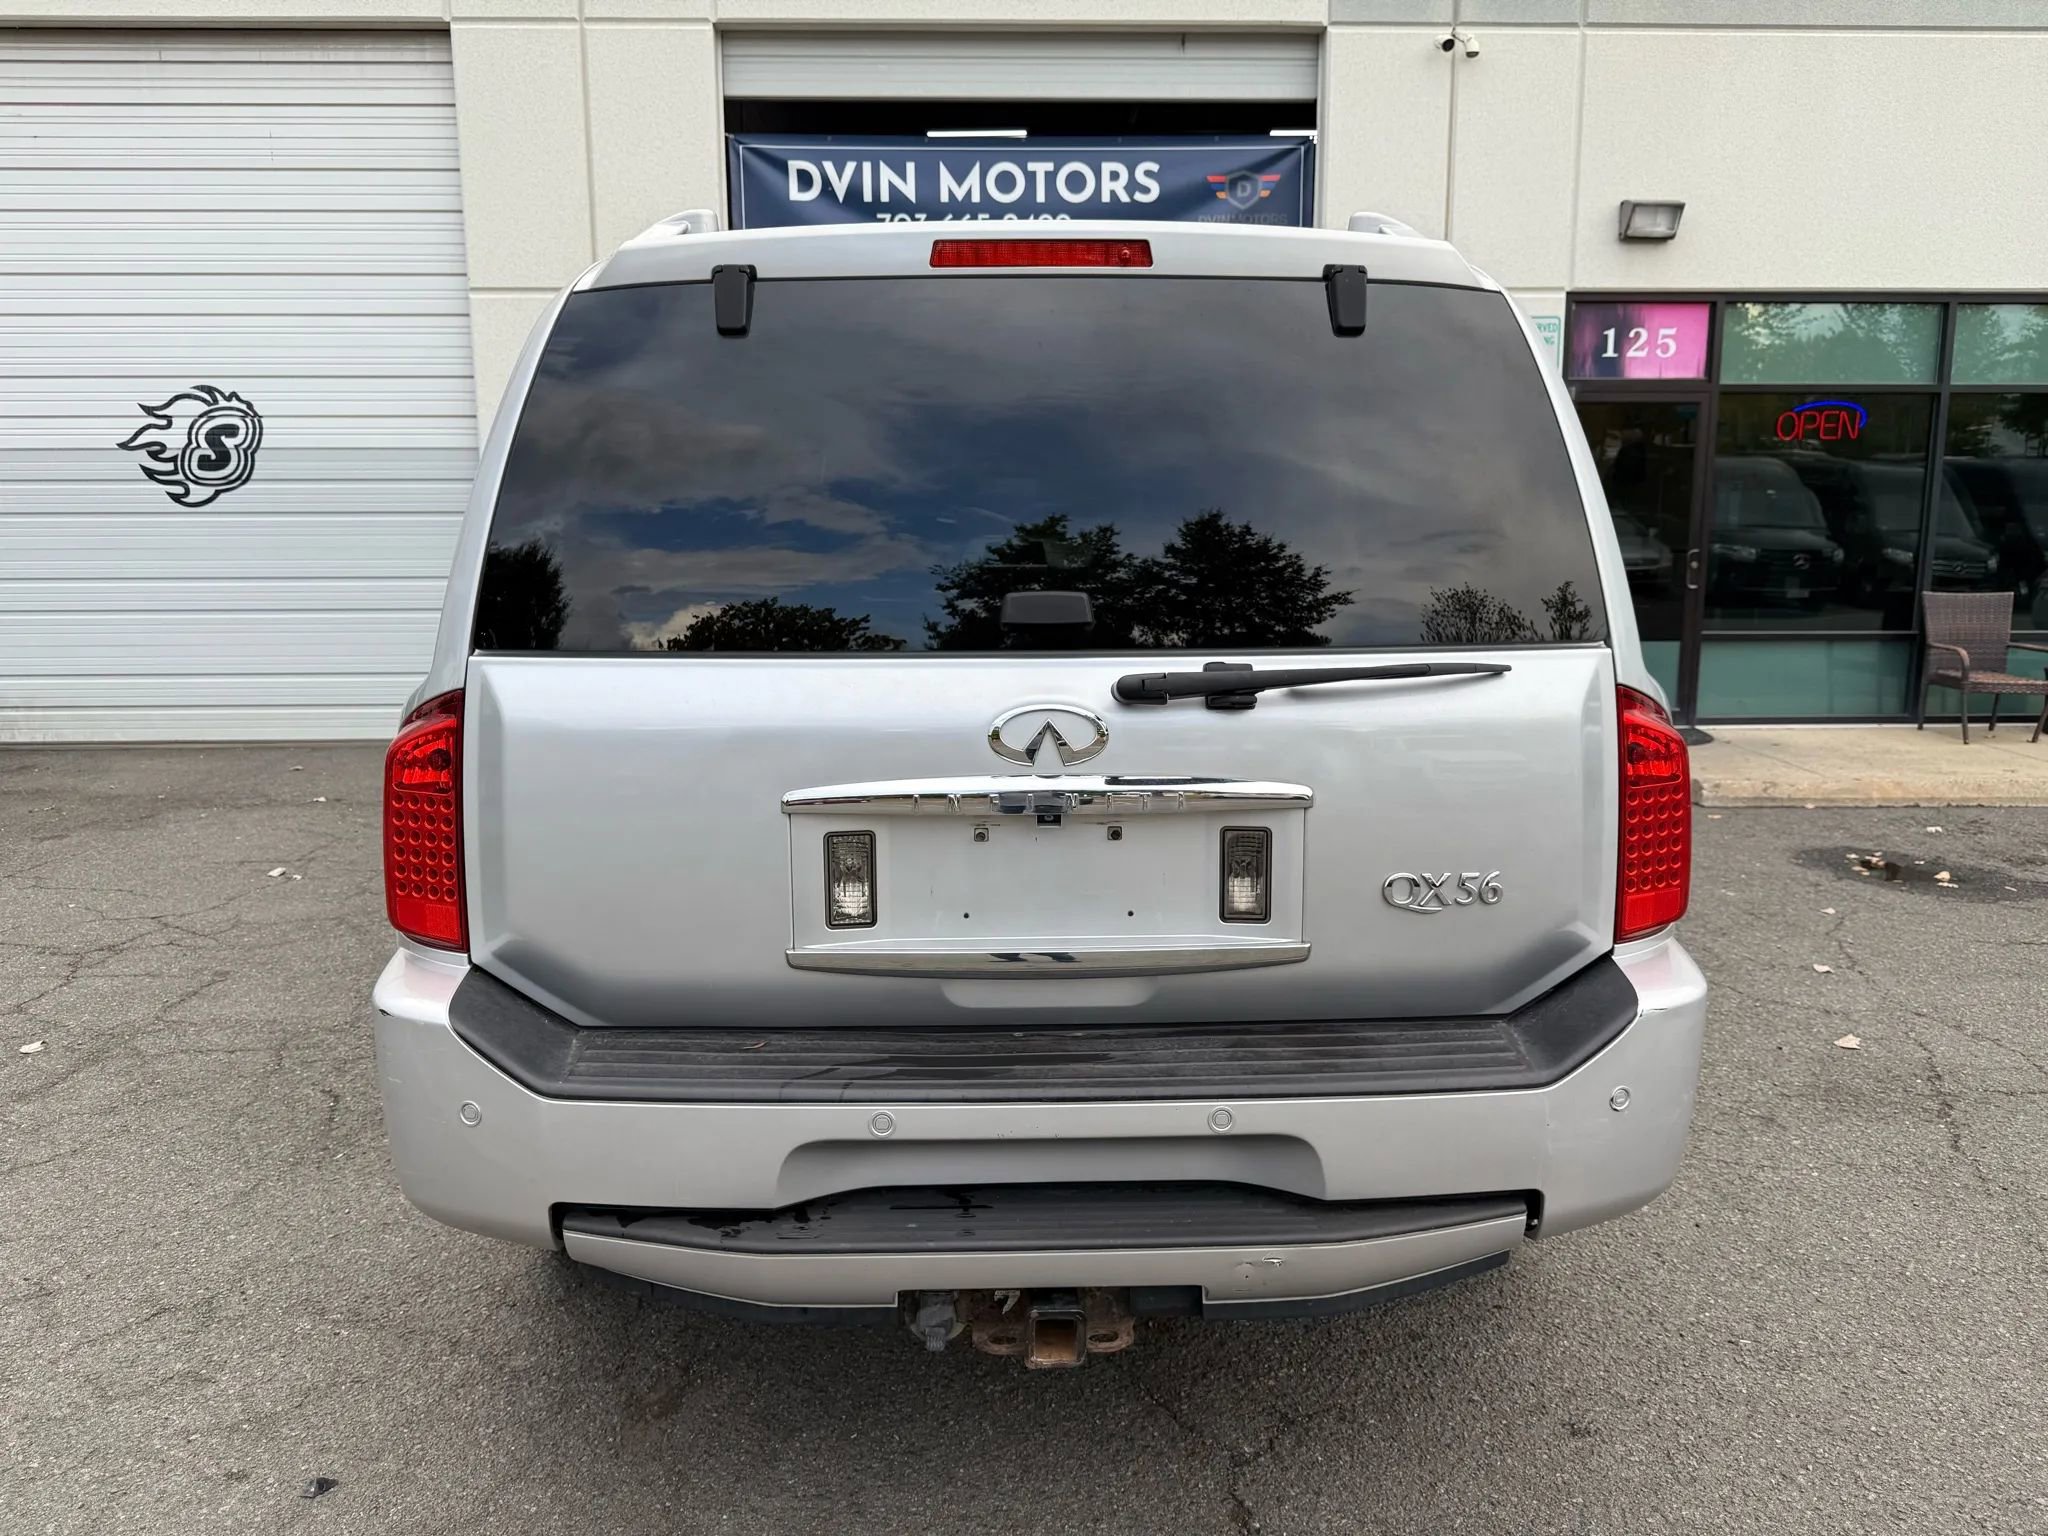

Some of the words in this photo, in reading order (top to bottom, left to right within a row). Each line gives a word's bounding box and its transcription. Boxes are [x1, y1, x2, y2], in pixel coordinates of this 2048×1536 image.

[787, 160, 916, 204] DVIN
[939, 160, 1160, 204] MOTORS
[1602, 327, 1677, 358] 125
[1776, 411, 1860, 441] OPEN
[1382, 870, 1504, 914] QX56
